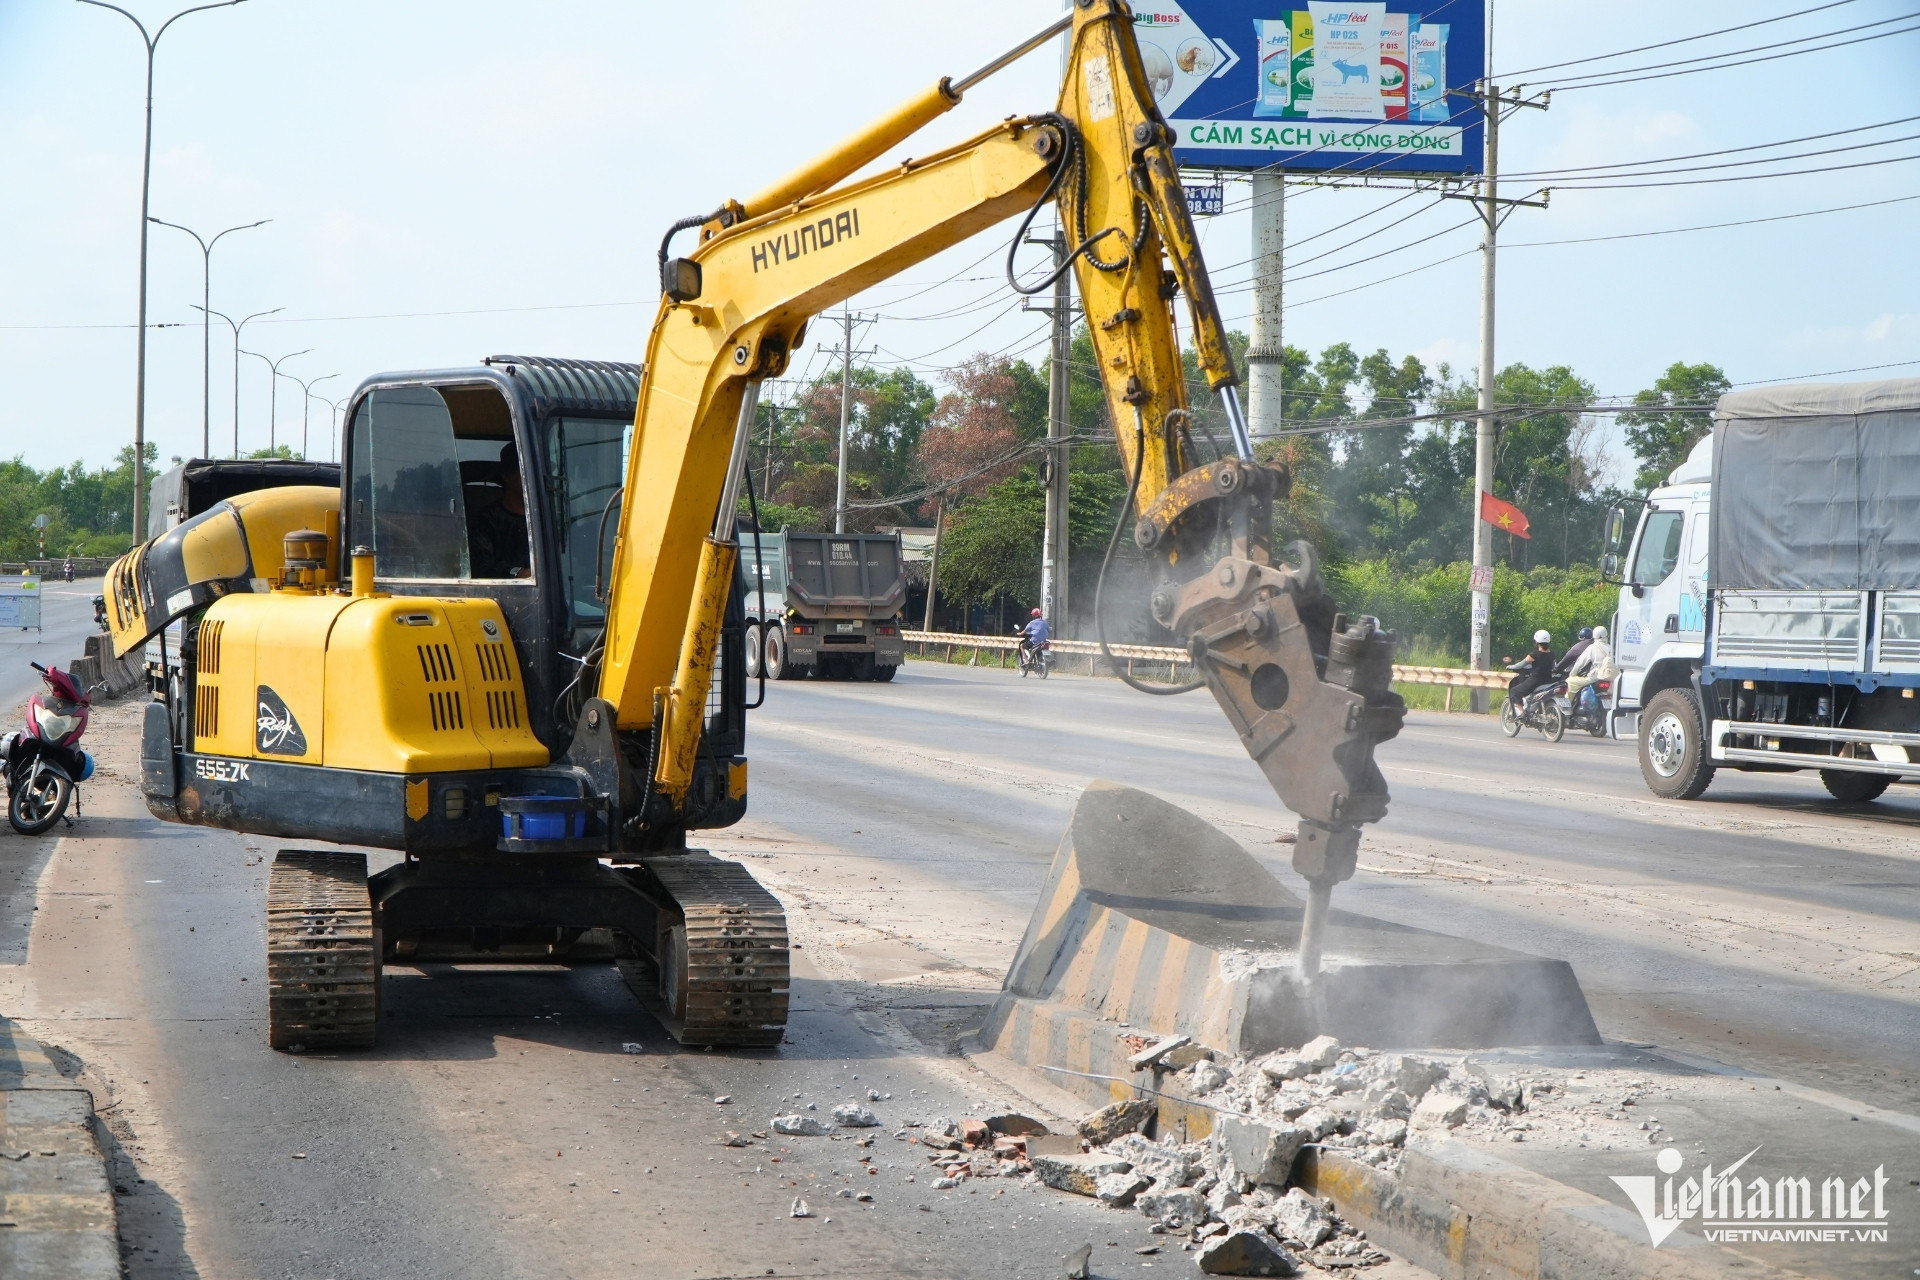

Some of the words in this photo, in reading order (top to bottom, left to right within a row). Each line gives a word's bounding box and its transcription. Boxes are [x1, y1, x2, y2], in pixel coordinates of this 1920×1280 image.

[1136, 13, 1180, 24] BigBoss
[1331, 31, 1341, 39] HP
[1343, 31, 1359, 40] 02S
[1190, 122, 1242, 144] CÁM
[1250, 127, 1311, 150] SẠCH
[1319, 130, 1335, 146] VÌ
[751, 208, 860, 274] HYUNDAI
